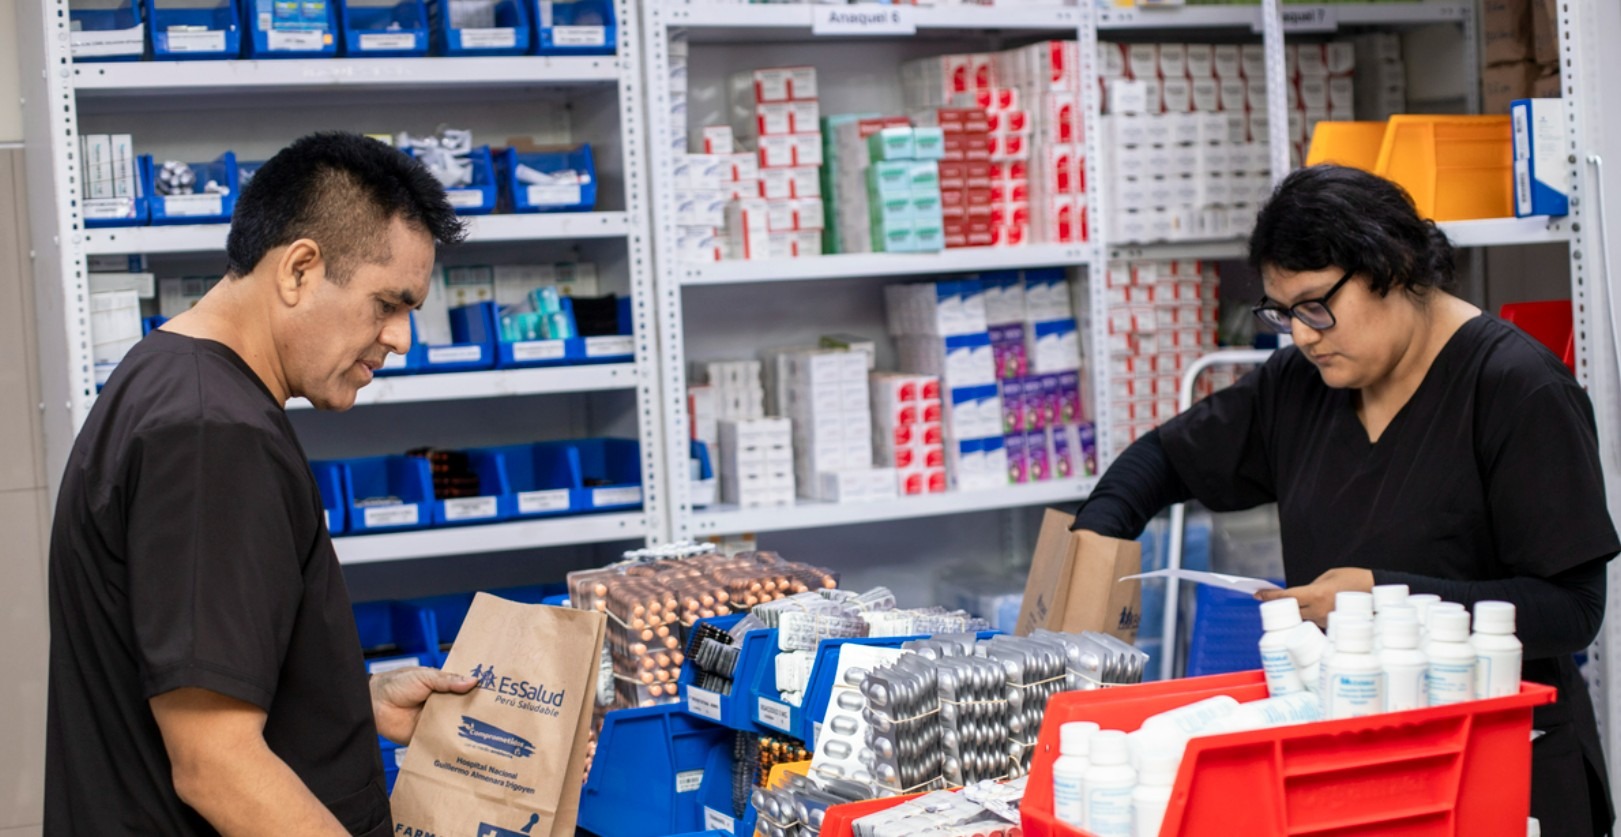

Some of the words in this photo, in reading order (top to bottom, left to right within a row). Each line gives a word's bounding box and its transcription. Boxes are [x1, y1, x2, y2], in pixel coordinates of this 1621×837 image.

[829, 11, 887, 25] Anaquel
[1282, 9, 1315, 24] aquel
[498, 676, 565, 708] EsSalud
[495, 695, 516, 707] Perú
[517, 700, 559, 717] Saludable
[433, 759, 470, 776] Guillermo
[471, 771, 504, 787] Almenara
[505, 781, 535, 795] Irigoyen
[456, 756, 487, 771] Hospital
[488, 766, 518, 780] Nacional
